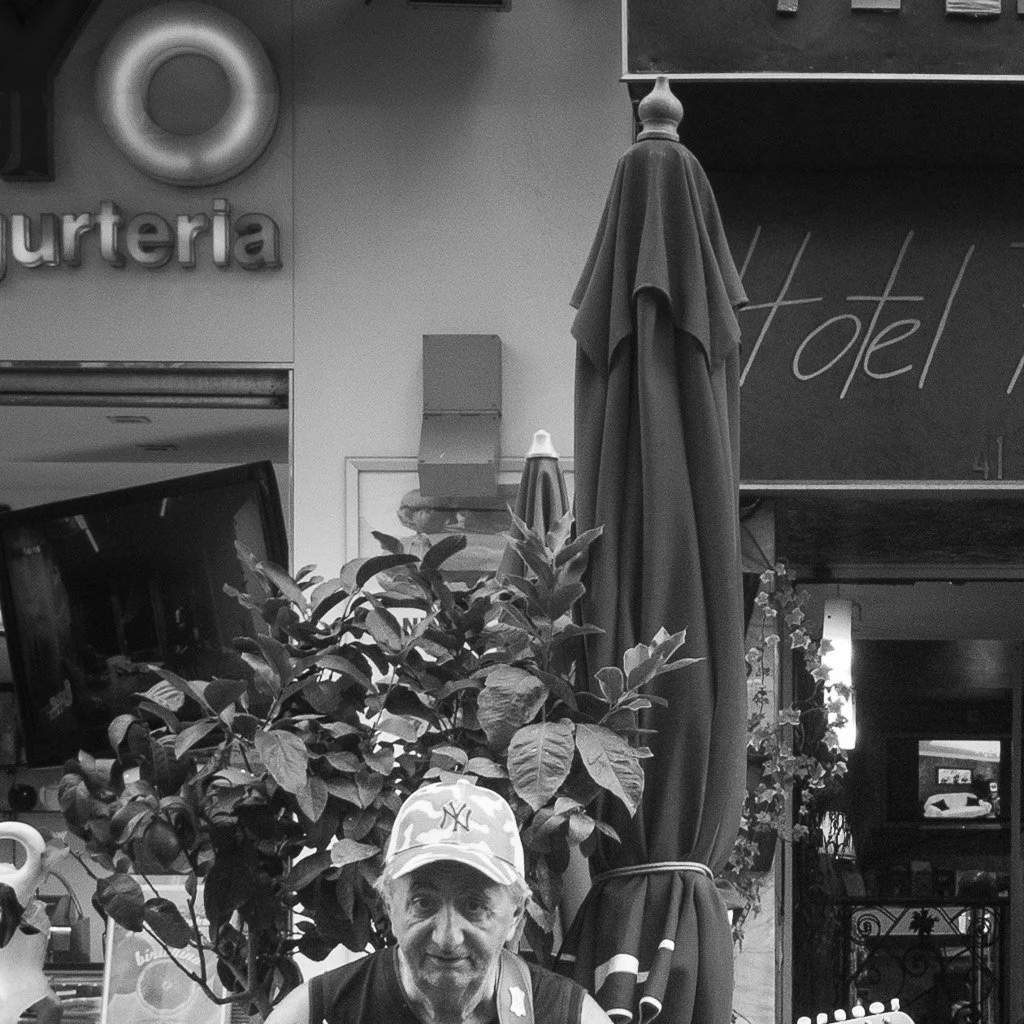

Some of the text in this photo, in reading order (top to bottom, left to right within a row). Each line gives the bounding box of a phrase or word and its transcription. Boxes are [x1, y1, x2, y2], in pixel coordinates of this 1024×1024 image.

[0, 198, 282, 280] urteria
[738, 226, 975, 399] Hotel
[440, 801, 472, 832] NY
